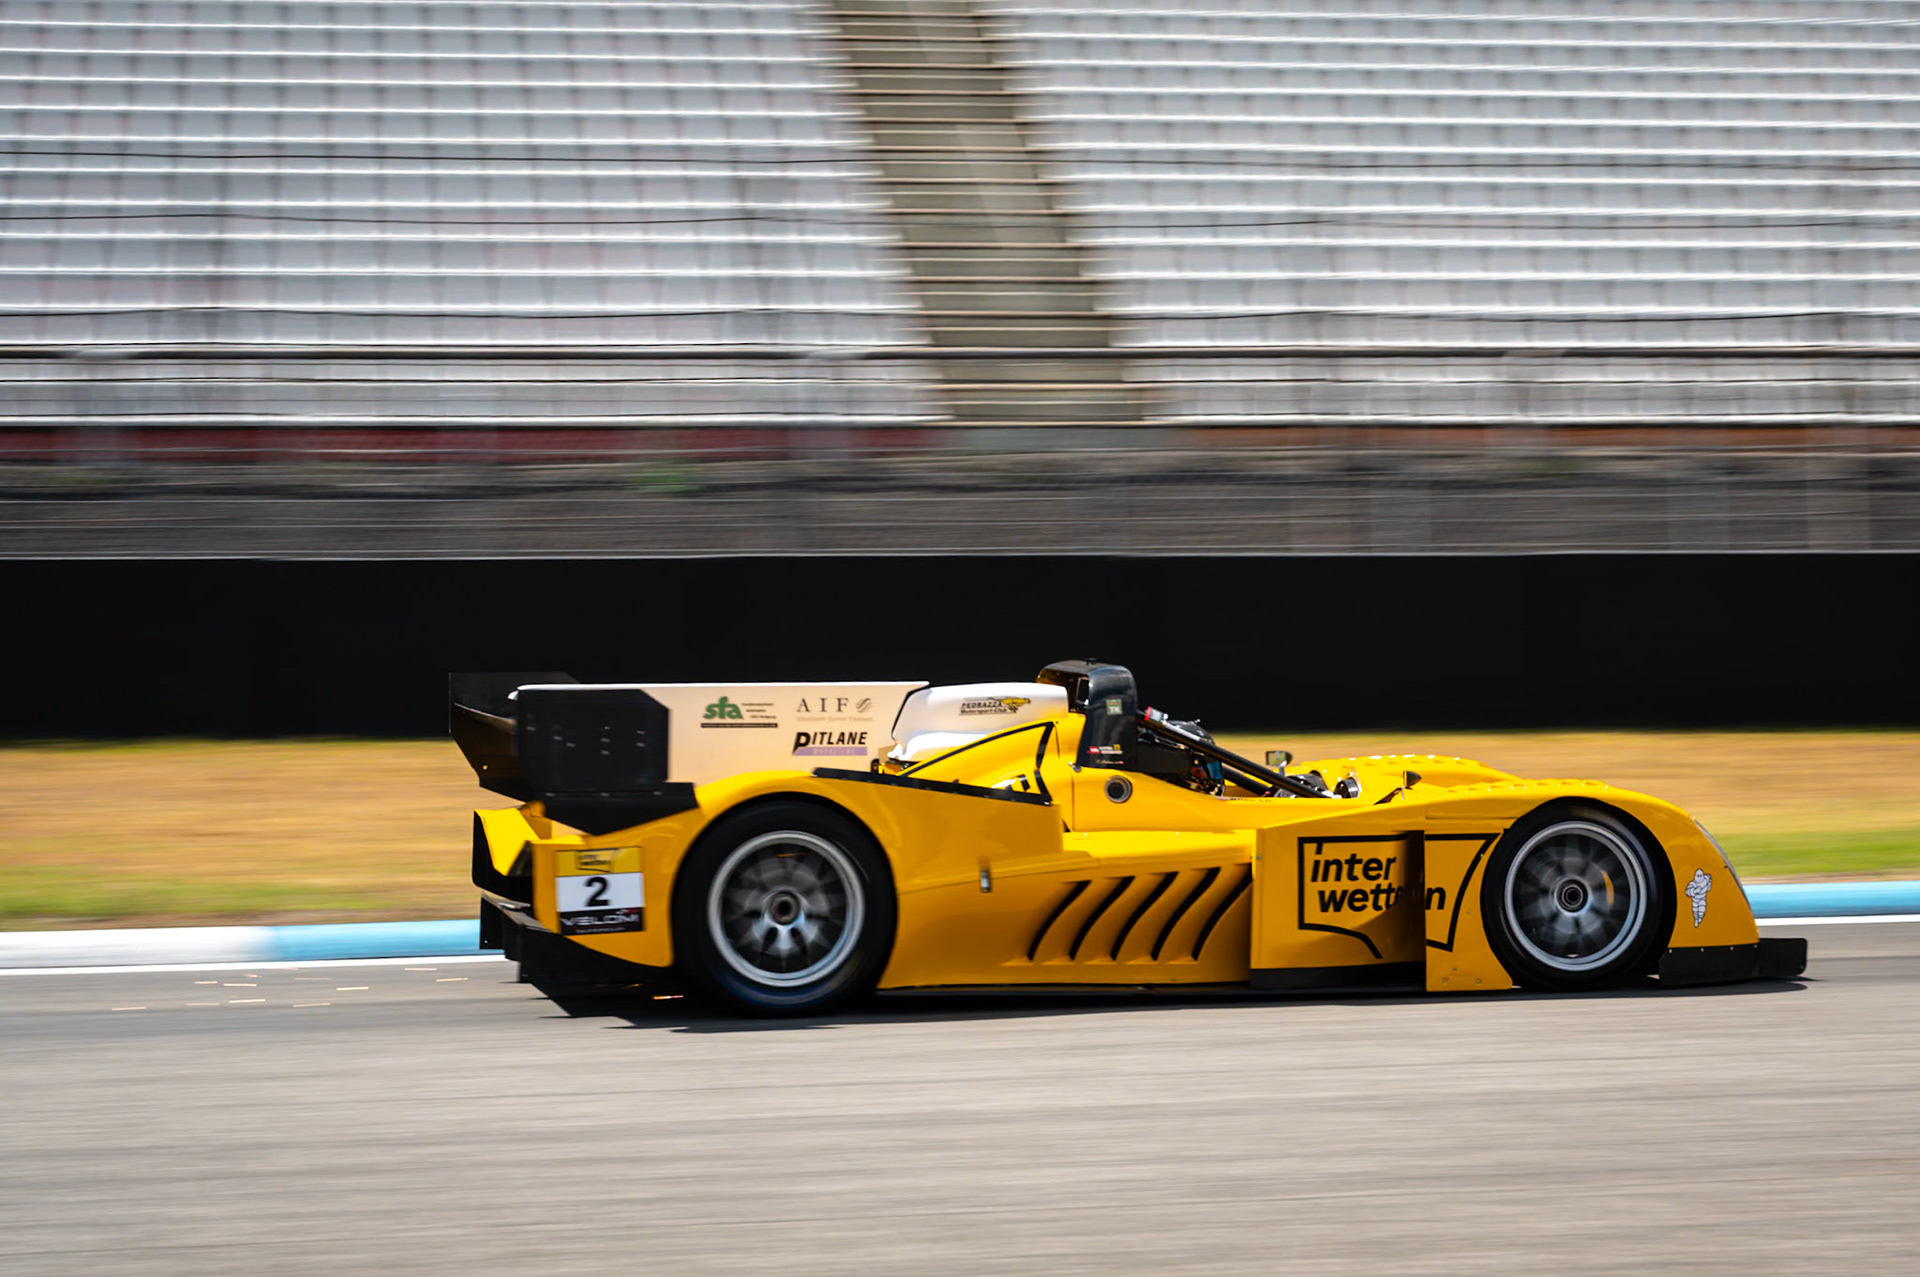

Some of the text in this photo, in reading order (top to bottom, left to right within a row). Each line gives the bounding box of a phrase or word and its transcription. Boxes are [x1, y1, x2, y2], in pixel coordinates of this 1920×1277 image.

[703, 696, 744, 719] sfa
[961, 701, 1002, 709] PEDRAZZA
[792, 731, 868, 755] PITLANE
[1311, 842, 1397, 882] inter
[584, 876, 610, 908] 2
